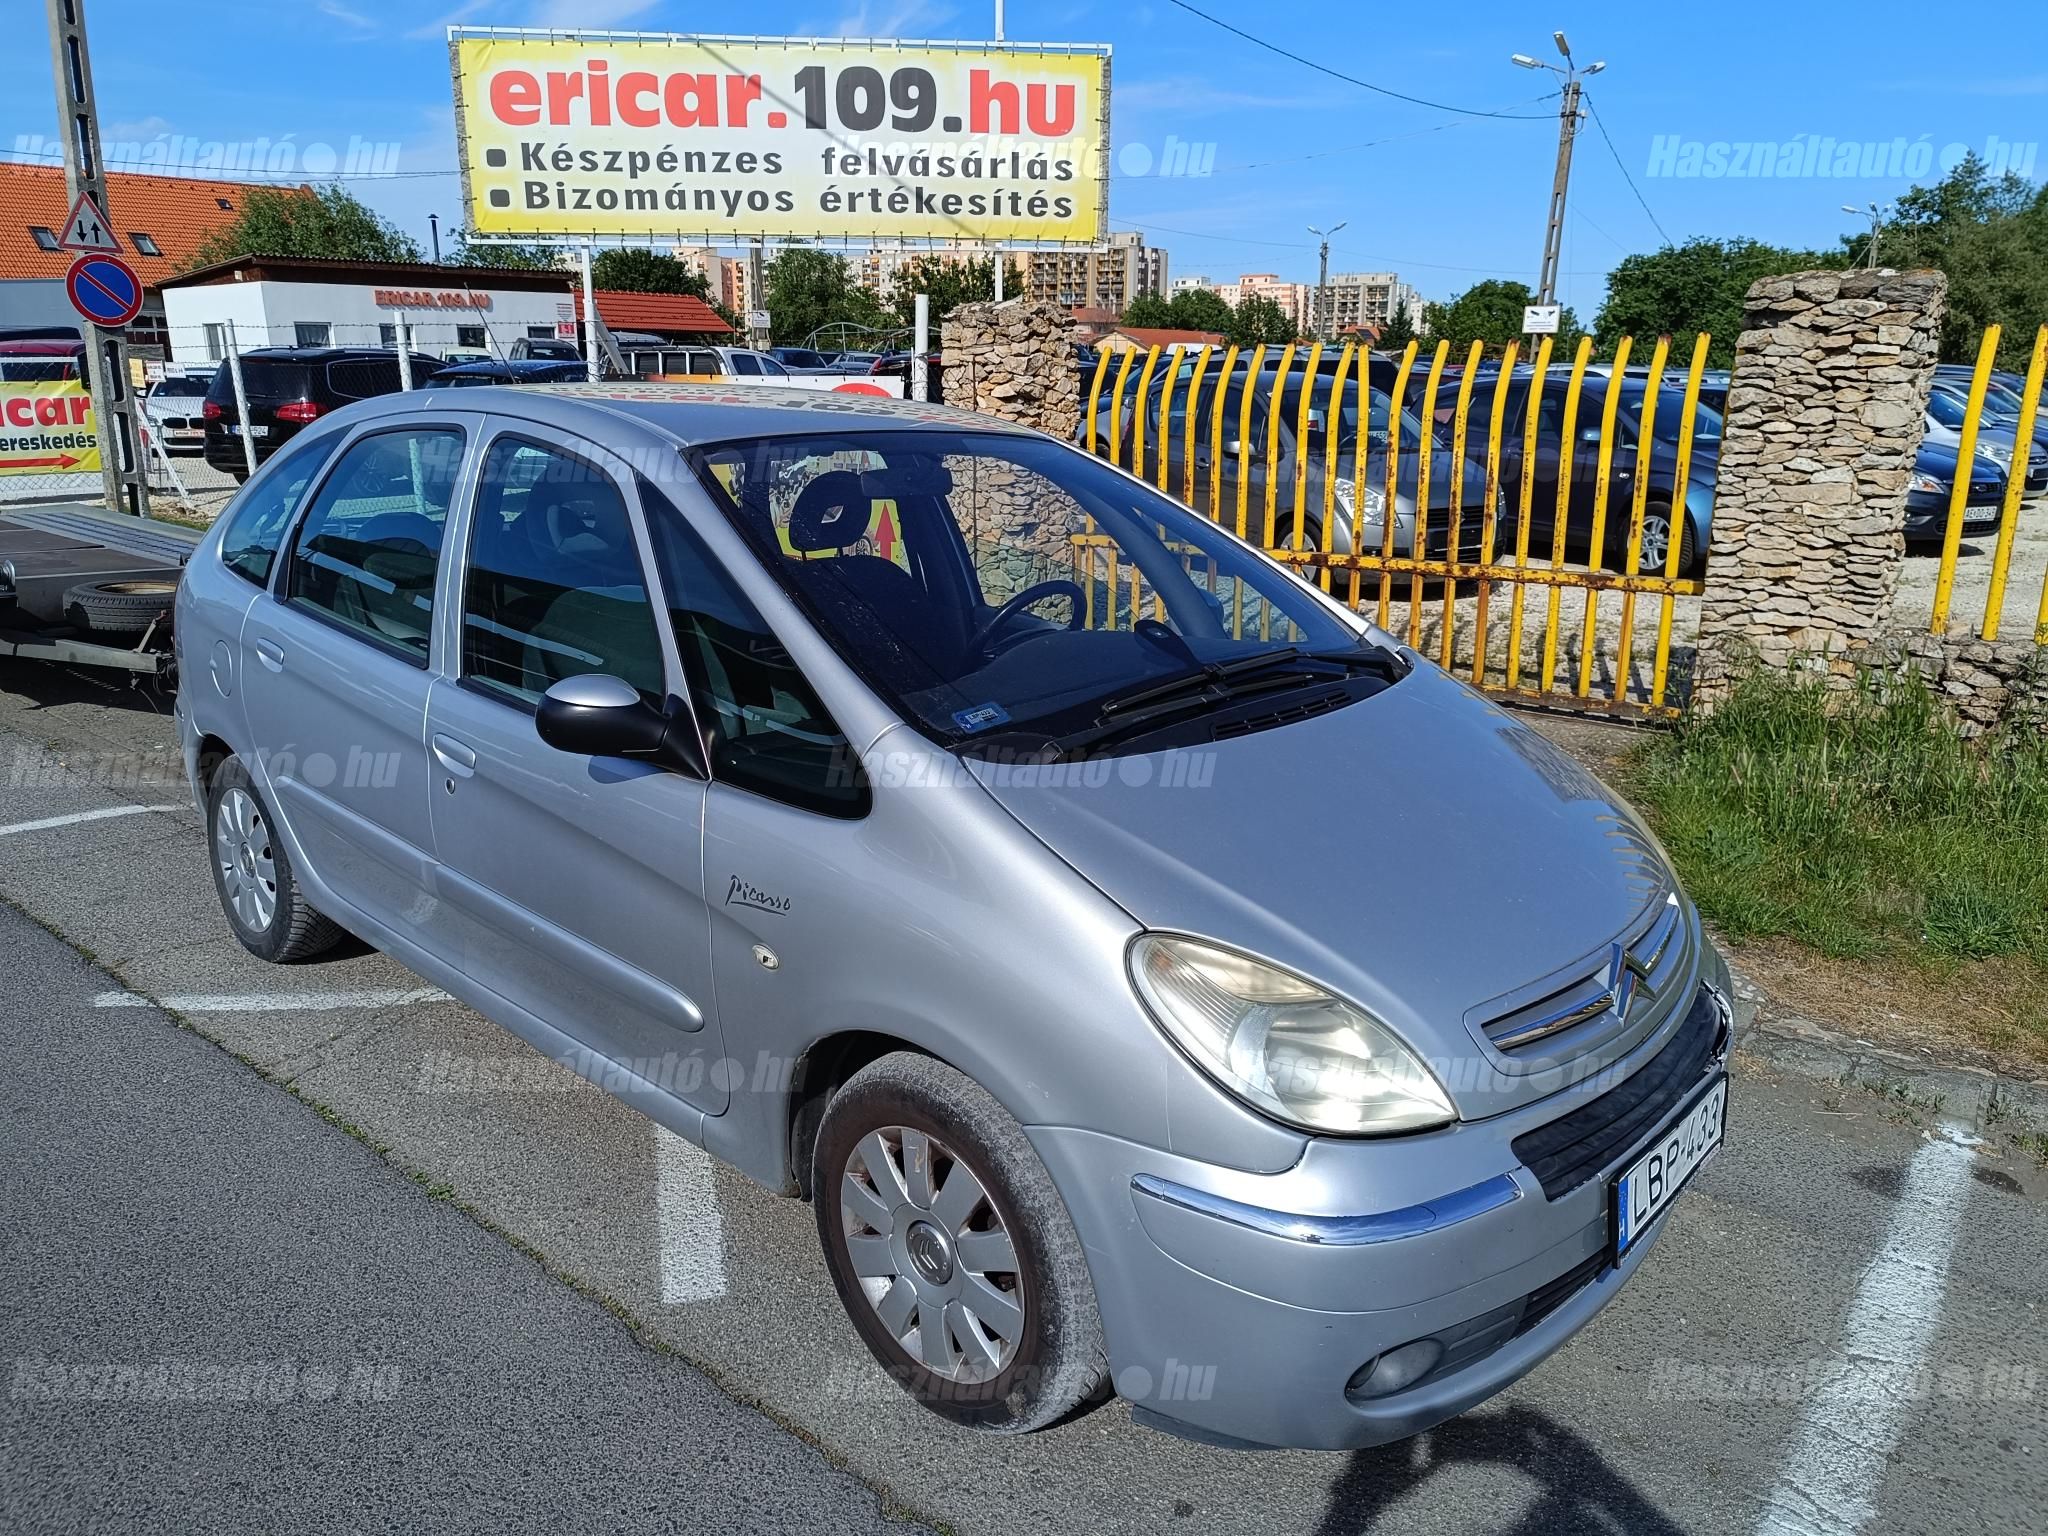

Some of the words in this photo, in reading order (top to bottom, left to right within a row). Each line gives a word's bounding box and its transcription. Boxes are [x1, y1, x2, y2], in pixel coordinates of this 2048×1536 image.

[490, 60, 1075, 136] ericar.109.hu
[521, 143, 782, 178] Készpénzes
[821, 147, 1073, 181] felvásárlás
[525, 181, 793, 217] Bizományos
[820, 184, 1072, 218] értékesítés
[725, 874, 791, 911] Picasso
[1633, 1092, 1720, 1228] LBP-433
